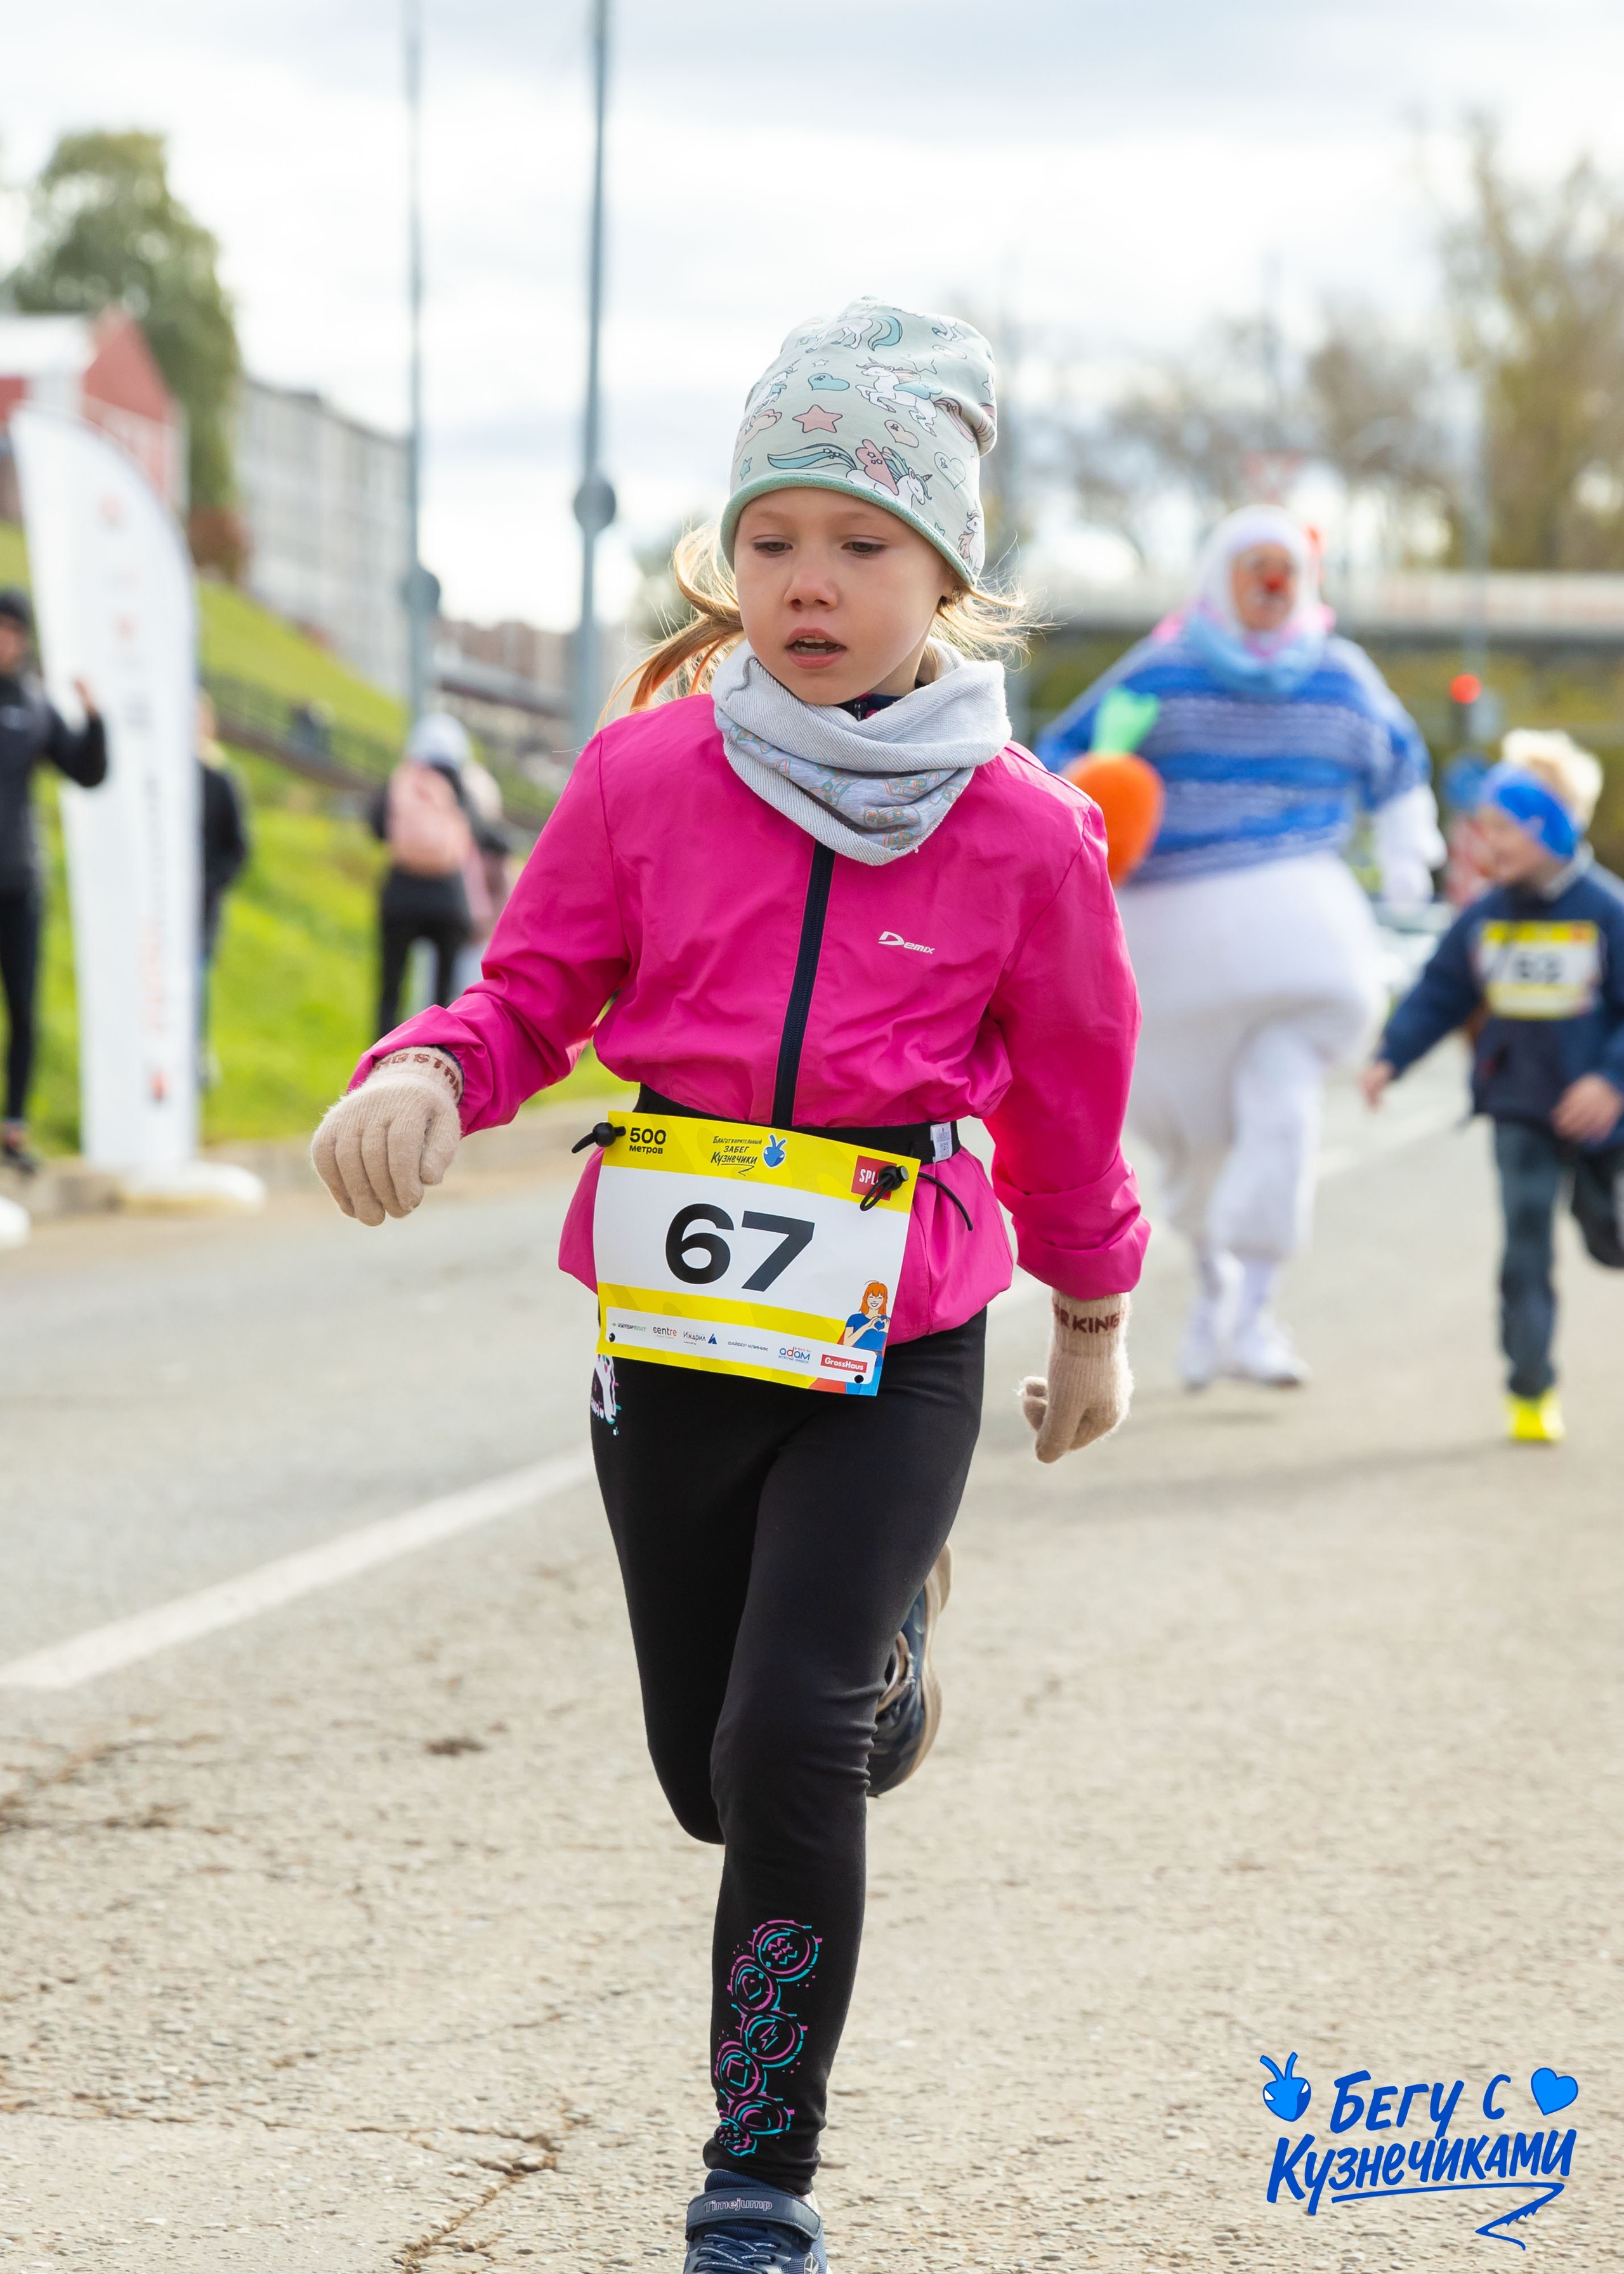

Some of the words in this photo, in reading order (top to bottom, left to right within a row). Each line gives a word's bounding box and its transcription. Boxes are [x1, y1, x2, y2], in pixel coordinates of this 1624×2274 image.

[878, 931, 935, 954] Demix
[629, 1127, 667, 1145] 500
[629, 1145, 664, 1155] метров
[723, 1145, 750, 1153] ЗАБЕГ
[665, 1203, 815, 1292] 67
[653, 1326, 678, 1337] centre
[824, 1357, 864, 1371] GrossHaus
[704, 2197, 773, 2212] Timejump
